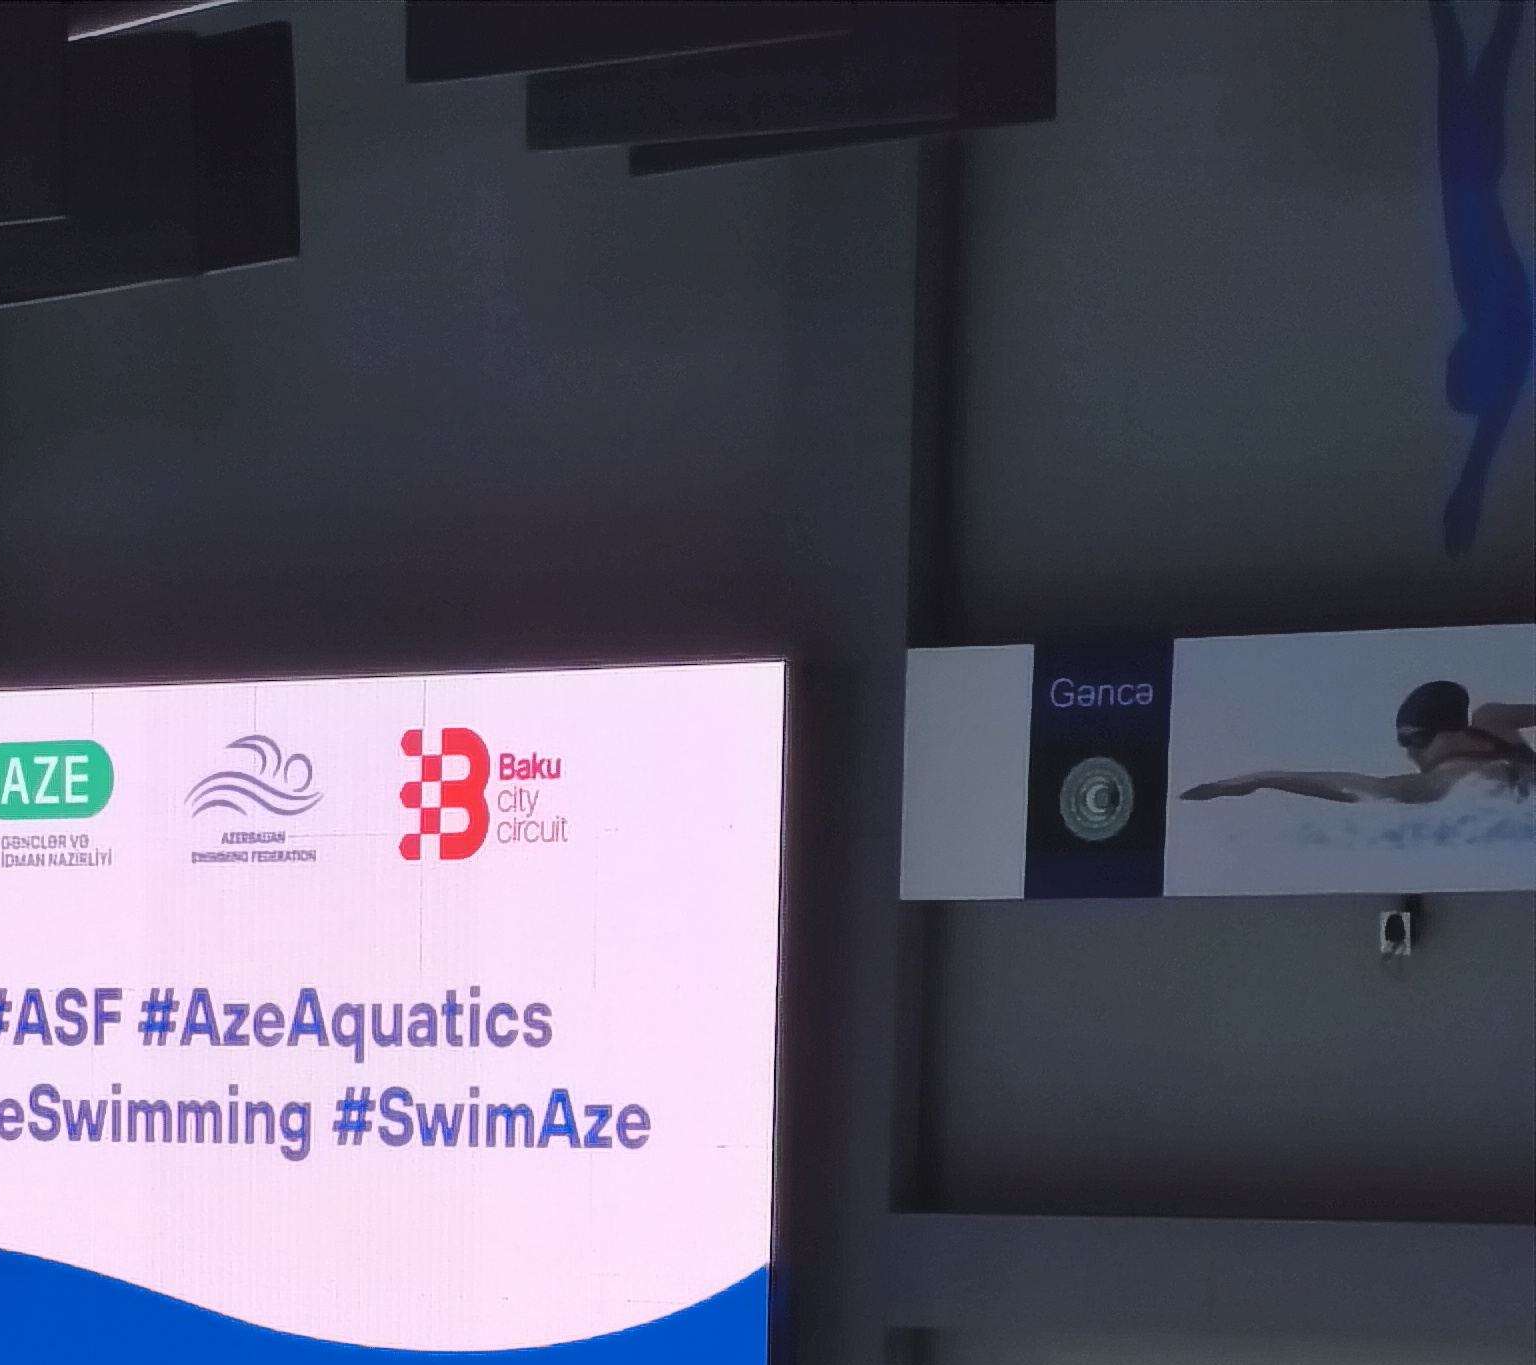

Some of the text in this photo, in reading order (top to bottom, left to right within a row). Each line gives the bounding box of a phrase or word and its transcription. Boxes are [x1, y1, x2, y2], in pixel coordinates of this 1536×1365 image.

[1049, 676, 1154, 708] Gəncə
[1, 755, 89, 805] AZE
[499, 752, 562, 781] Baku
[497, 786, 540, 818] city
[496, 816, 568, 844] circuit
[138, 985, 553, 1064] #AzeAquatics
[332, 1085, 651, 1150] #SwimAze
